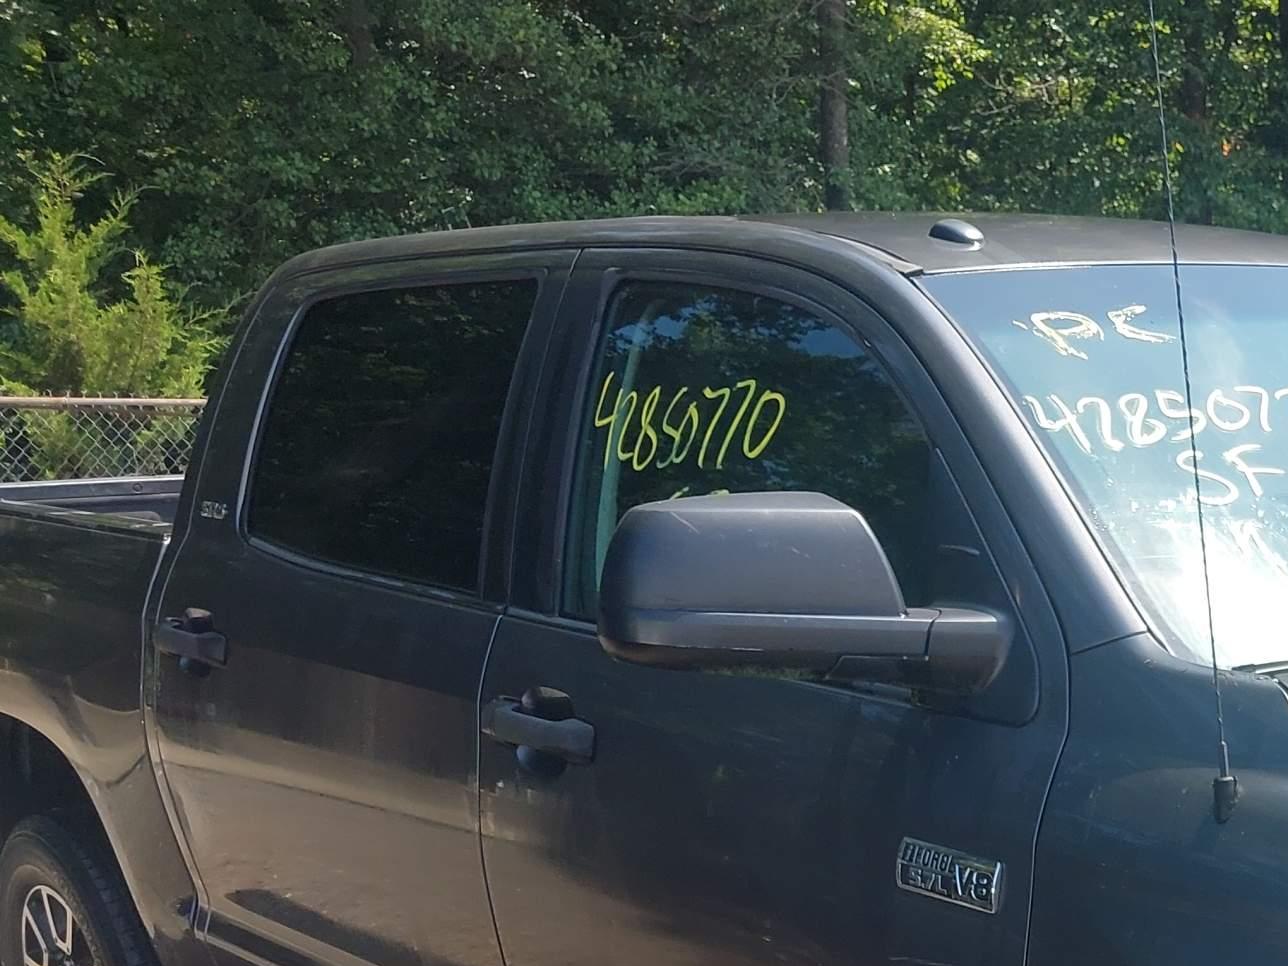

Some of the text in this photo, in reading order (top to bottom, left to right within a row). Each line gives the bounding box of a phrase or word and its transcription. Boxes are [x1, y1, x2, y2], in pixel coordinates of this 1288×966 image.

[594, 371, 786, 472] 42850770
[1176, 444, 1285, 506] SF
[955, 863, 994, 901] V8
